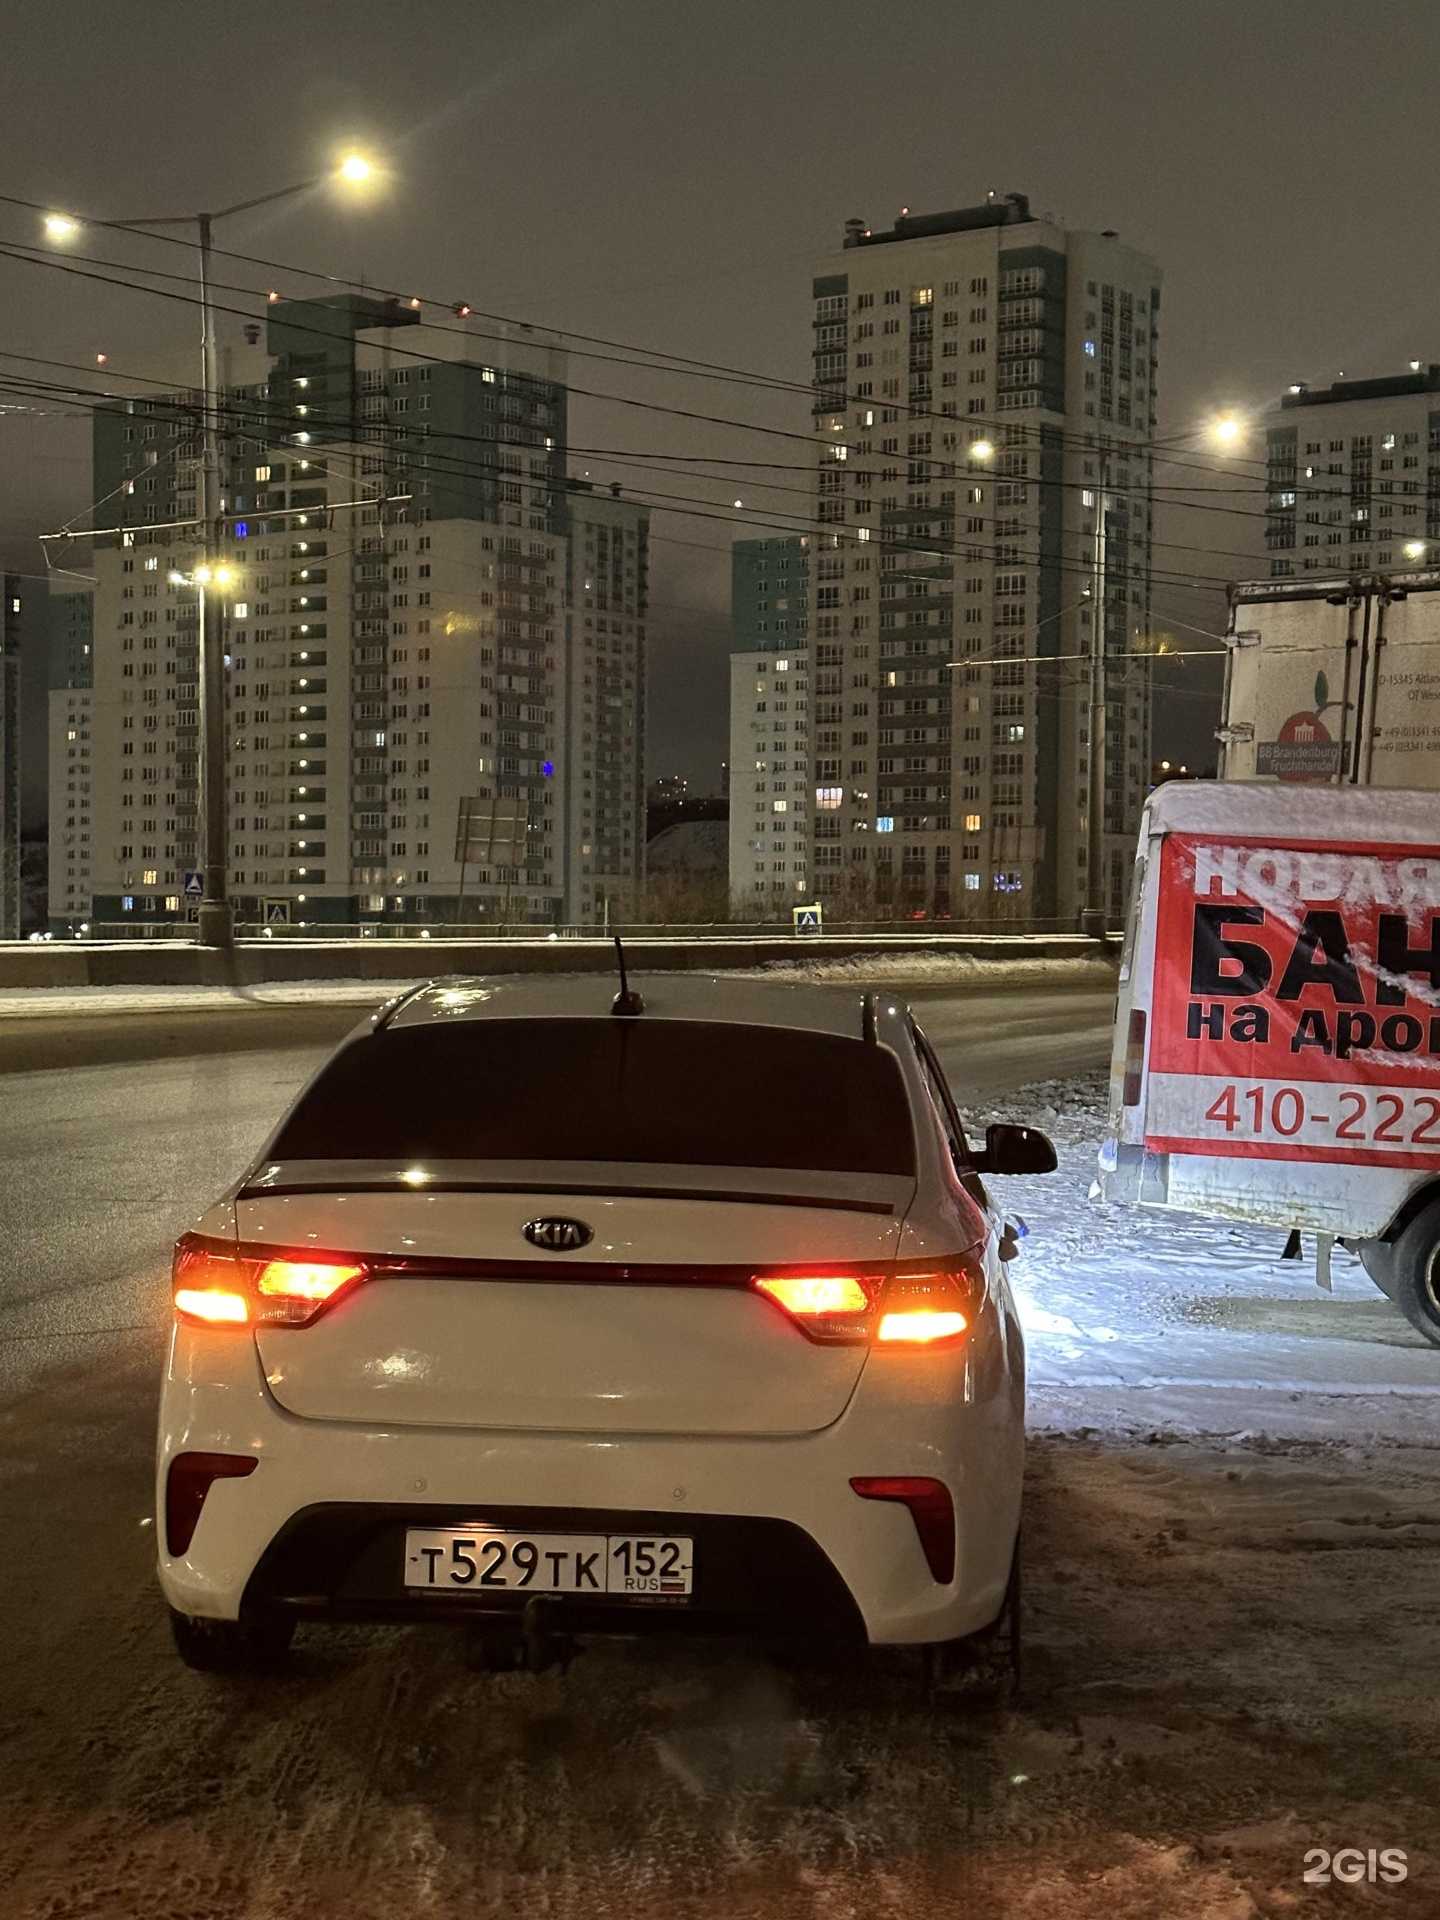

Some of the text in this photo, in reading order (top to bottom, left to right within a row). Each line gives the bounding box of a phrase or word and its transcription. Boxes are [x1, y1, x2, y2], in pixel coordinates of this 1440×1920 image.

[1273, 744, 1349, 762] Brandenburgr
[1194, 846, 1440, 908] НОВАЯ
[1186, 1002, 1270, 1045] на
[1205, 1085, 1440, 1144] 410-222
[534, 1223, 581, 1244] KIA
[613, 1541, 681, 1578] 152
[624, 1578, 659, 1591] RUS
